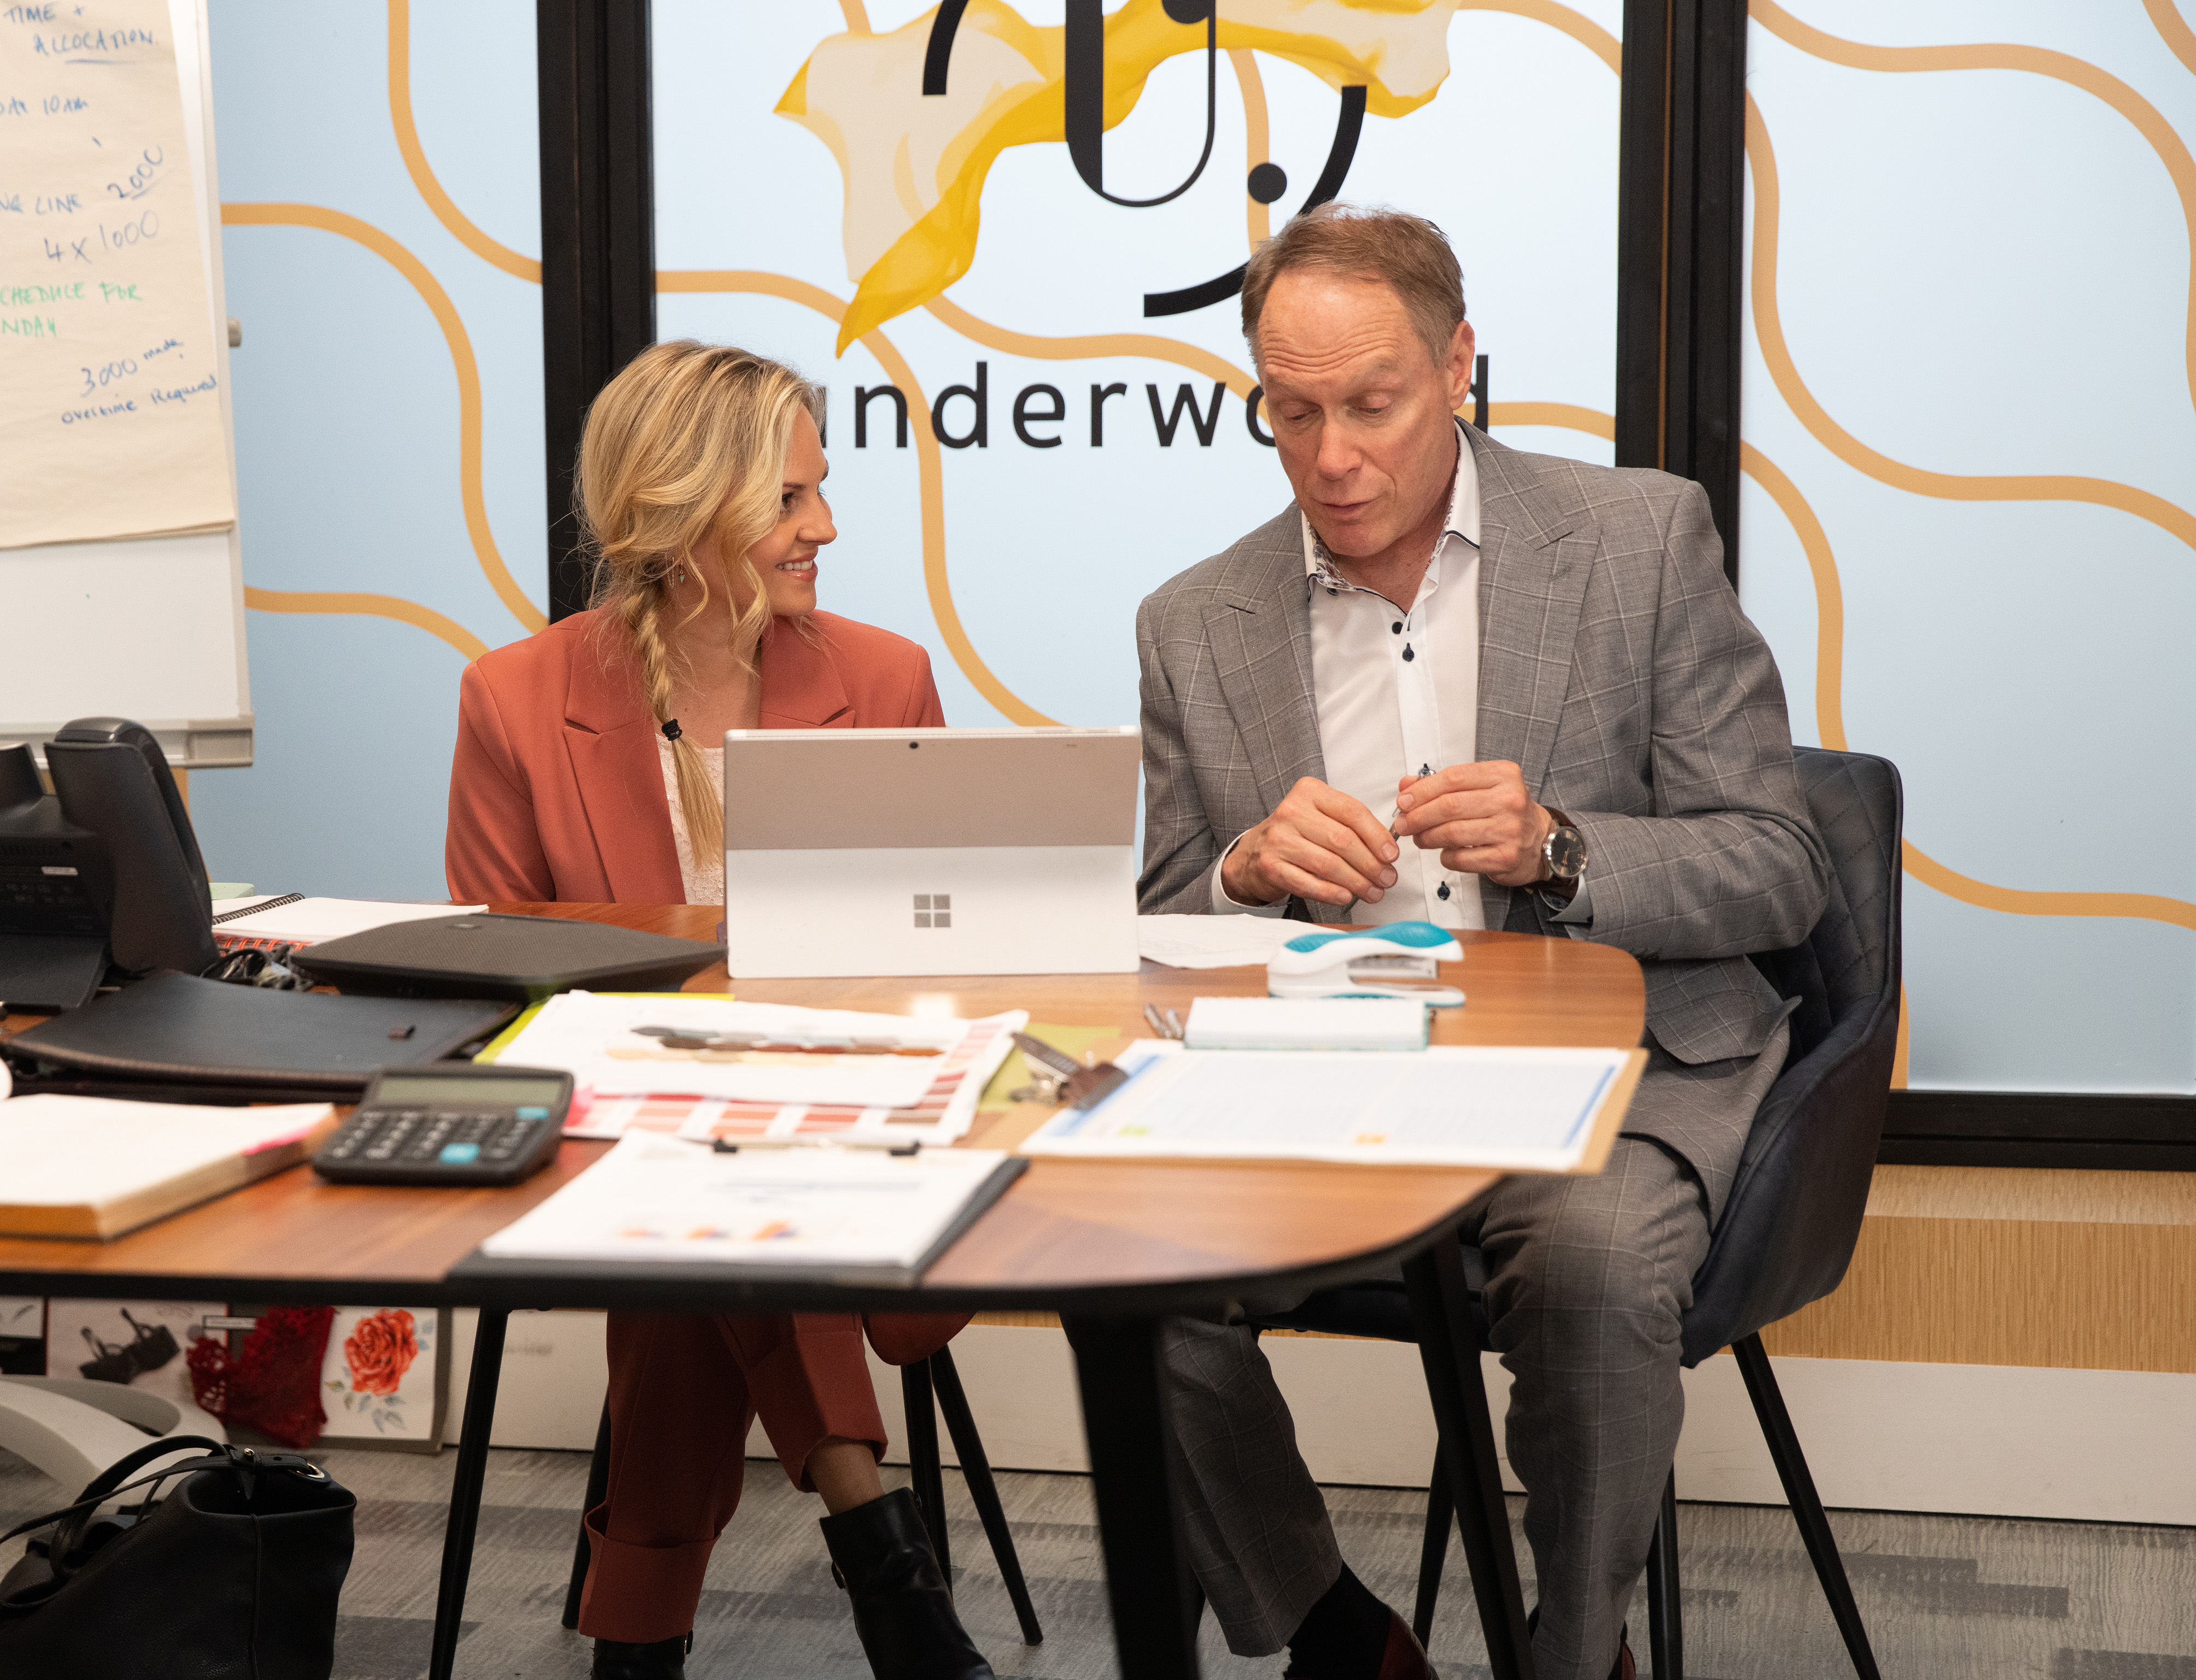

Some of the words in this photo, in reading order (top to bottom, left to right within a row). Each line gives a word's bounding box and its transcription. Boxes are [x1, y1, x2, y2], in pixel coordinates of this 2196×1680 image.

[3, 2, 56, 24] TIME
[34, 29, 153, 56] ALLOCATION
[44, 237, 64, 262] 4
[99, 209, 160, 251] 1000
[80, 358, 138, 399] 3000
